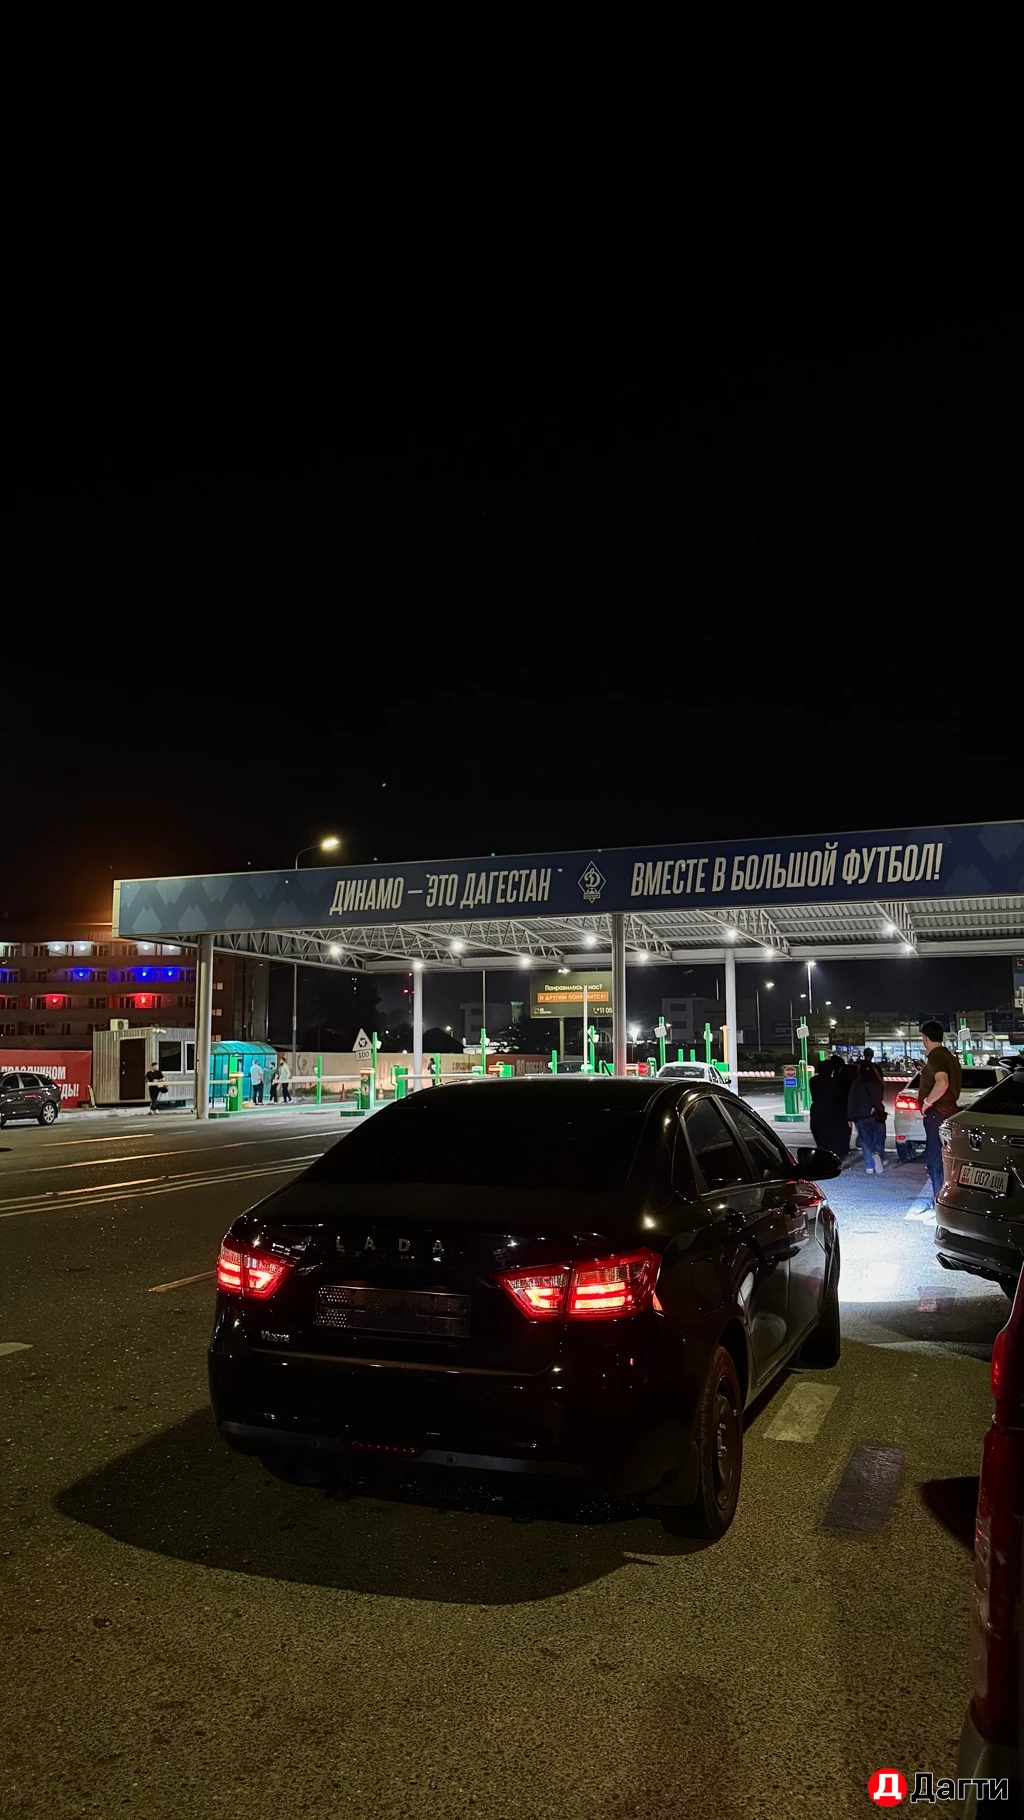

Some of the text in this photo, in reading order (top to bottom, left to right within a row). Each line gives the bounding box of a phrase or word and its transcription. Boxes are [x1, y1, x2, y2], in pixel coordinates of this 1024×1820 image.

[630, 842, 943, 896] ВМЕСТЕ В БОЛЬШОЙ ФУТБОЛ!
[329, 877, 404, 916] ДИНАМО
[426, 874, 458, 907] ЭТО
[460, 868, 551, 909] ДАГЕСТАН
[335, 1236, 445, 1254] LADA
[260, 1330, 290, 1344] VESTA
